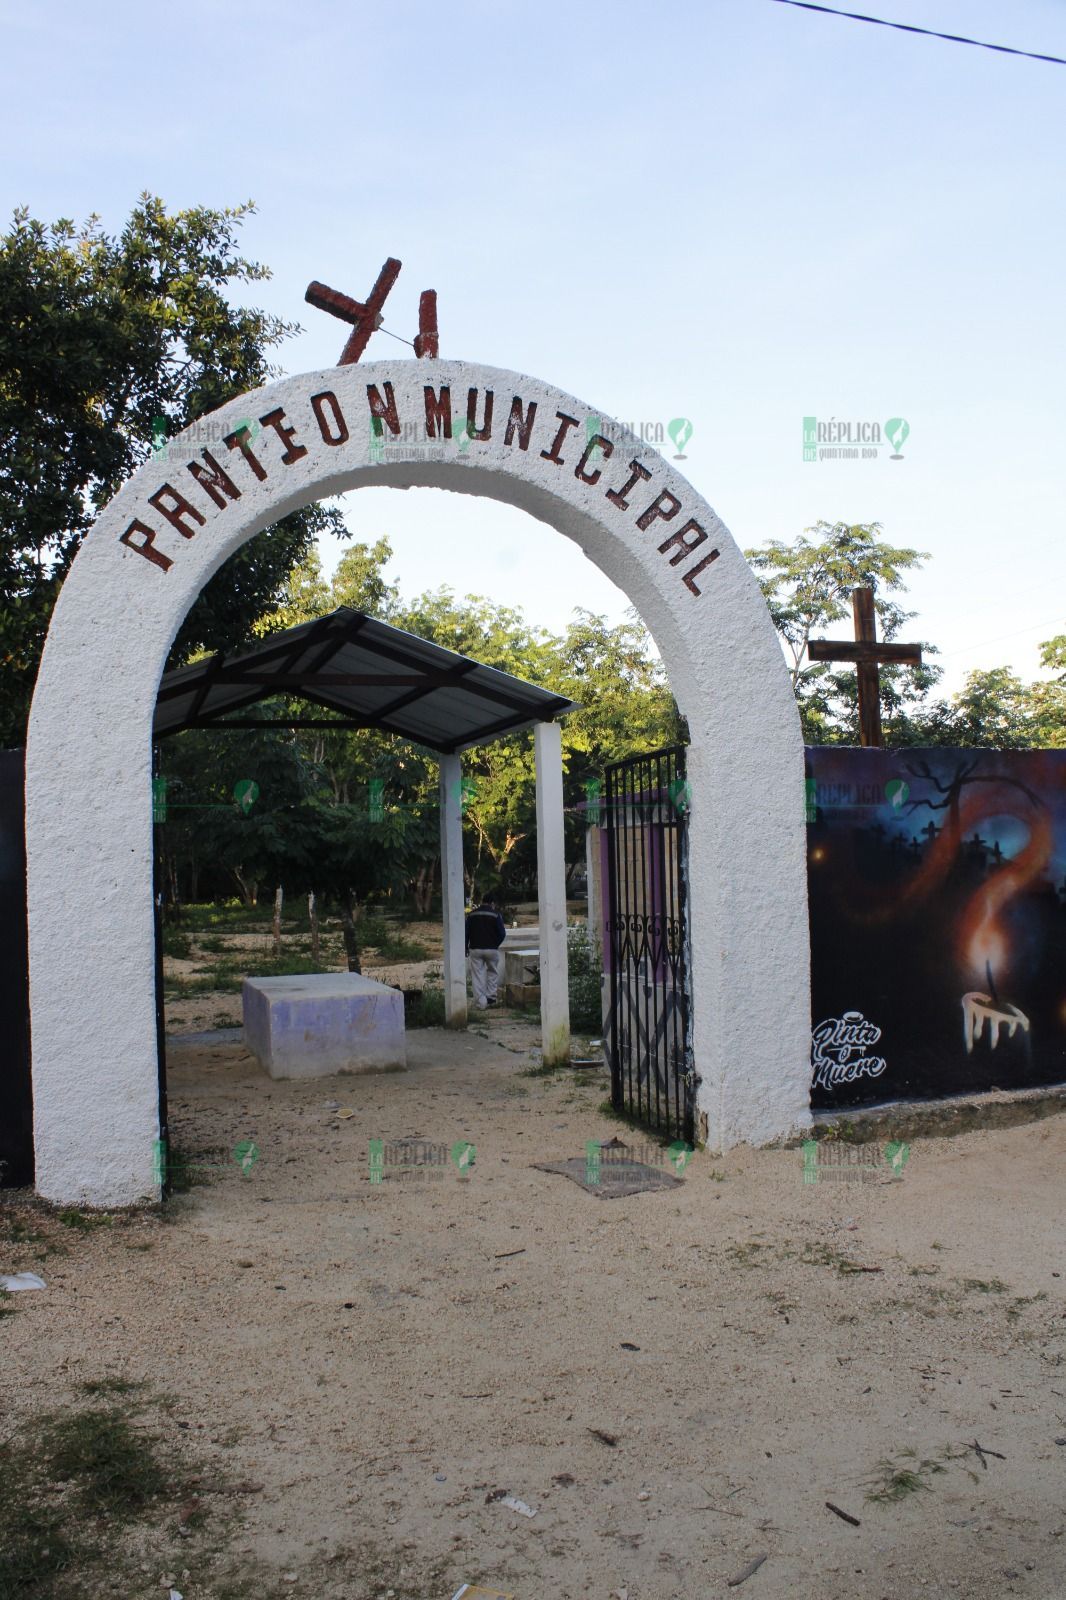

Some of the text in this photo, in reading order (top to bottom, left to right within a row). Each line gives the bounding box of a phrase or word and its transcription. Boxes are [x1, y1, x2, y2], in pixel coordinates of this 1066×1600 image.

[119, 381, 721, 597] PANTEON MUNICIPAL
[811, 1056, 887, 1090] Muere
